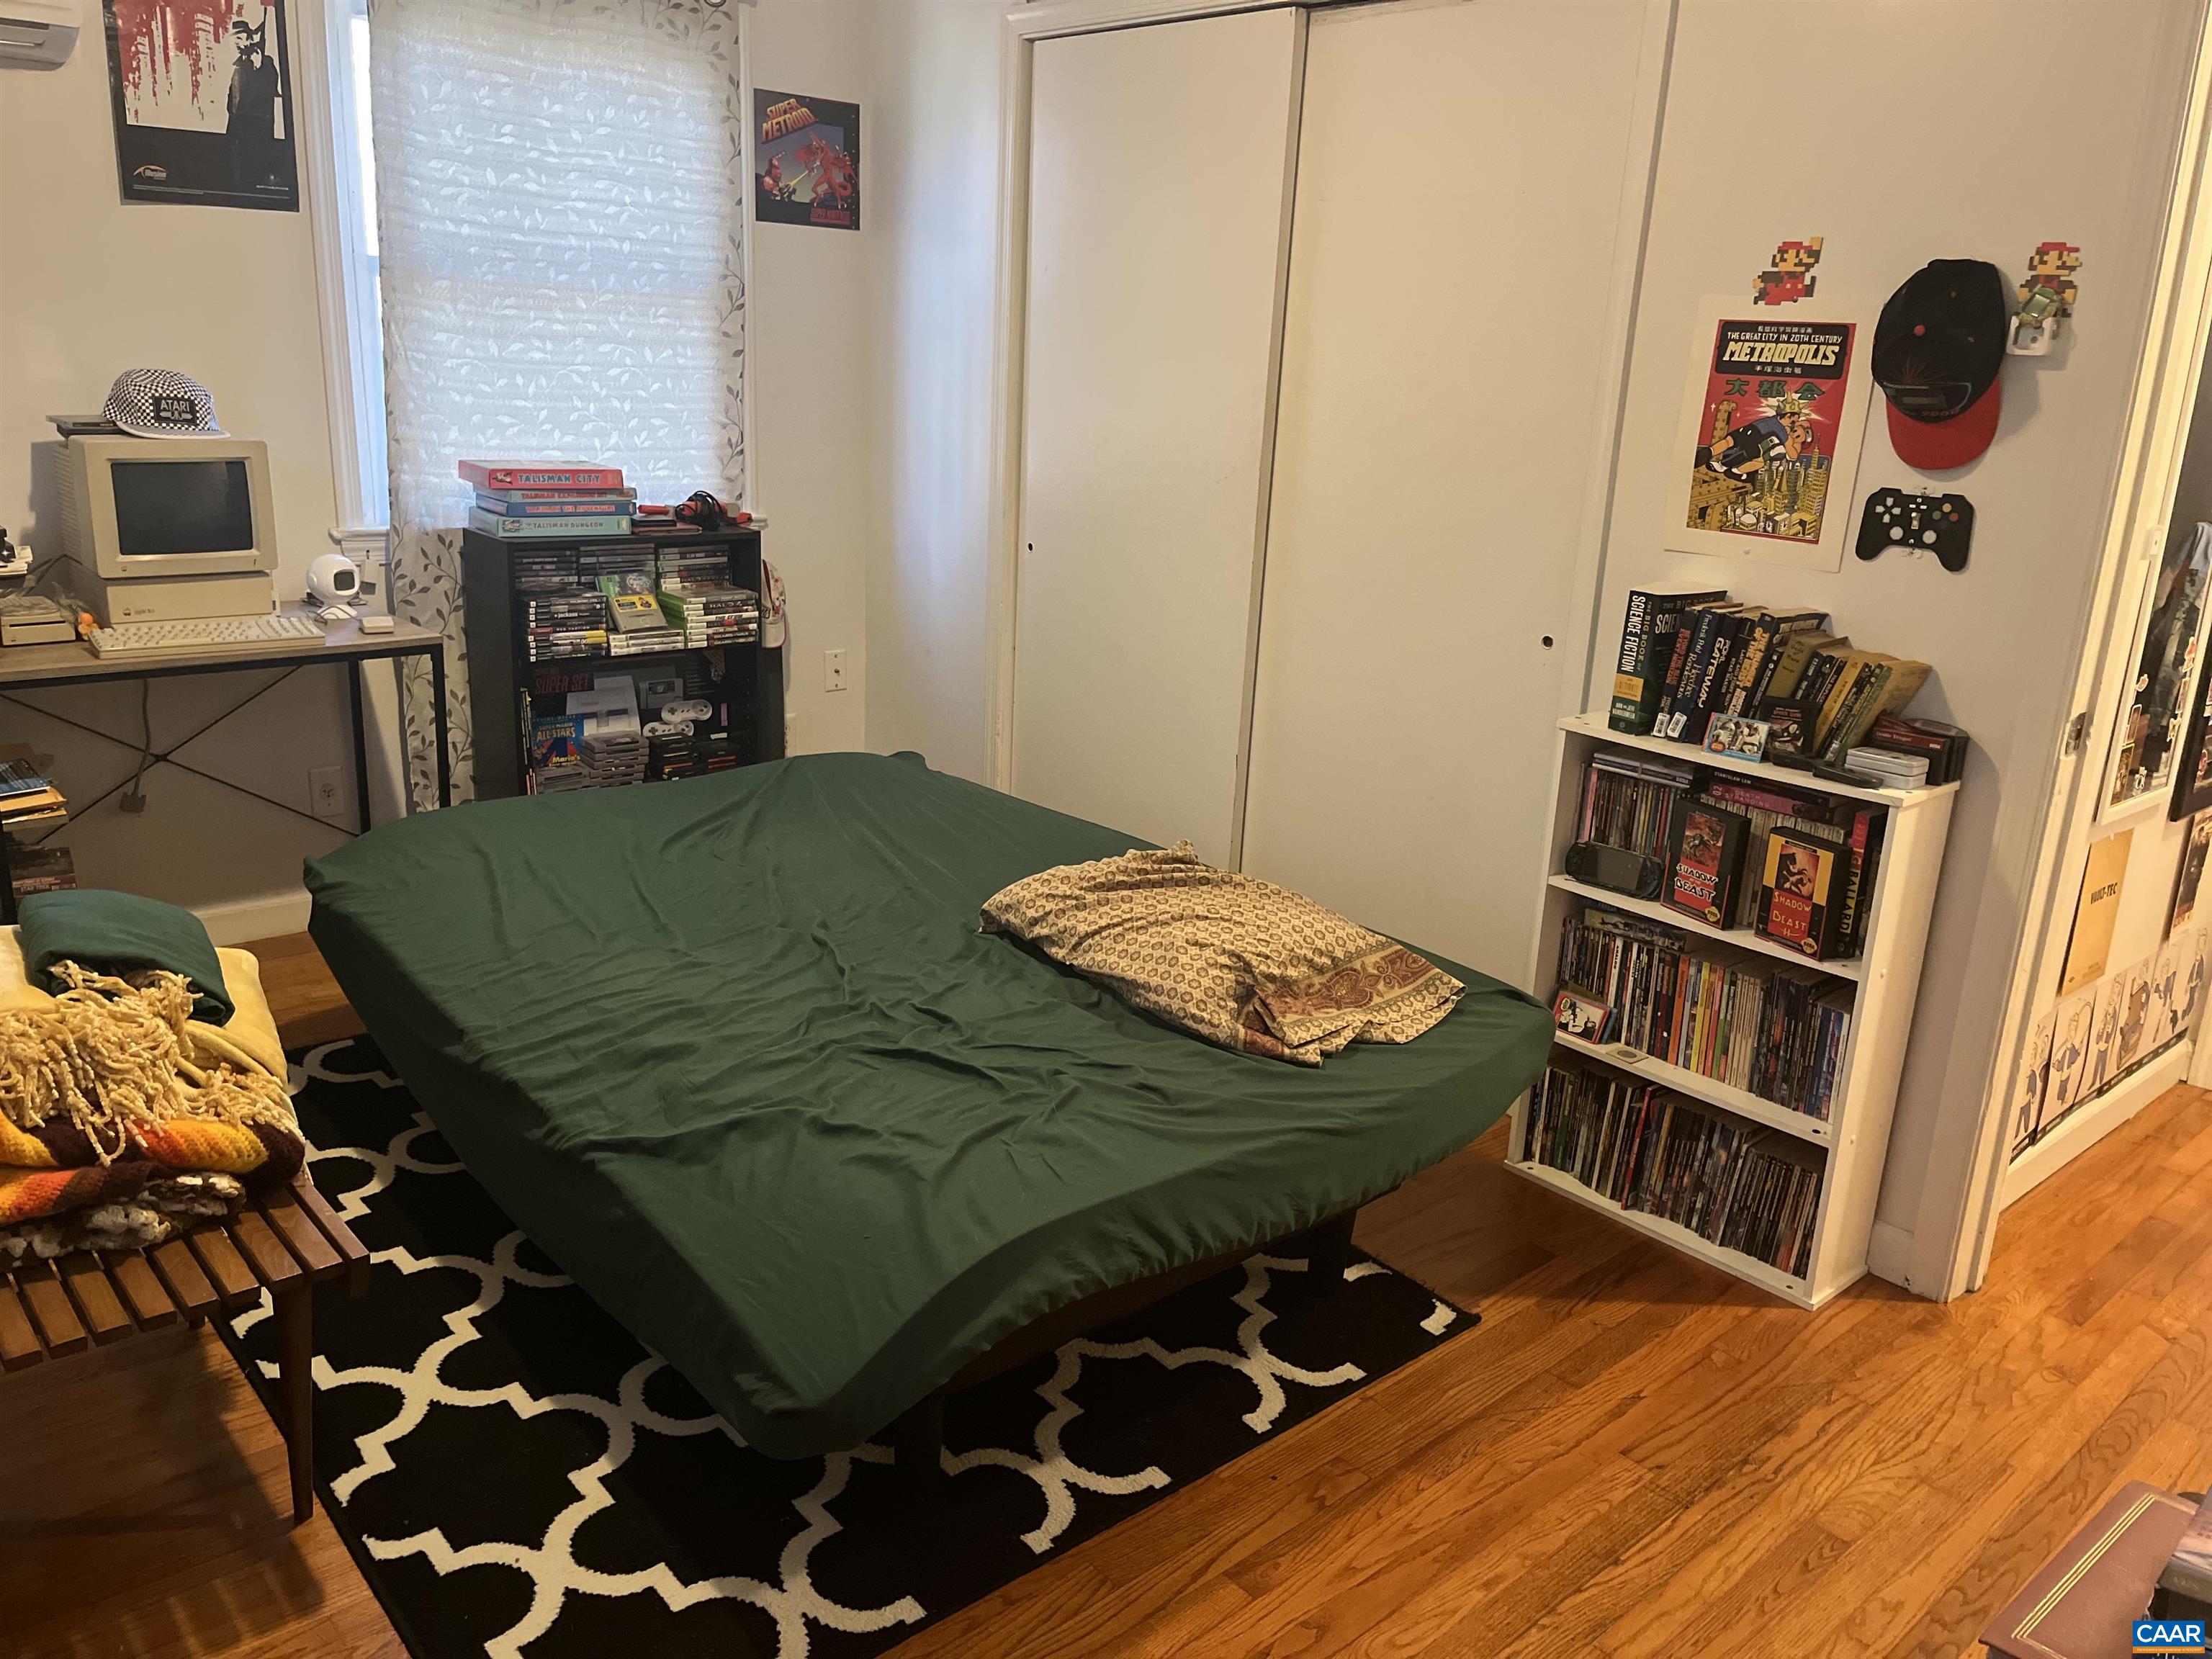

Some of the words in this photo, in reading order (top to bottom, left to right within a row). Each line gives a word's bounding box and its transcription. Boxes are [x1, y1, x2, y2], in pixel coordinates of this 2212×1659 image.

[766, 98, 803, 119] SUPER
[761, 108, 817, 144] METROID
[1728, 332, 1739, 341] THE
[1741, 332, 1760, 341] GREAT
[1762, 333, 1778, 341] CITY
[1810, 335, 1843, 343] CENTURY
[1722, 341, 1840, 366] METROPOLIS
[1725, 377, 1825, 401] 大都会
[161, 400, 189, 412] ATARI
[518, 474, 571, 484] TALISMAN
[577, 474, 601, 483] CITY
[1627, 595, 1646, 634] SCIENCE
[1676, 600, 1691, 608] BIG
[1642, 616, 1651, 631] BIG
[1753, 627, 1763, 641] OF
[1639, 634, 1648, 662] BOOK
[1679, 629, 1691, 653] BEYOND
[1695, 640, 1705, 654] Pohl
[1718, 639, 1731, 664] POHL
[1746, 642, 1758, 659] THE
[1758, 633, 1771, 652] THE
[1621, 636, 1639, 673] FICTION
[1676, 655, 1684, 667] THE
[1677, 653, 1693, 698] Rendezvous
[1698, 637, 1725, 709] GATEWAY
[1745, 652, 1763, 687] NUMBER
[536, 676, 568, 694] SUPER
[572, 674, 588, 691] SET
[1685, 664, 1702, 698] Heechee
[1721, 673, 1730, 693] MAKER
[1714, 771, 1740, 783] STANISLAW
[1725, 793, 1769, 809] STRANDING
[1735, 790, 1761, 799] DEATH
[1676, 863, 1718, 886] SHADOW
[1674, 876, 1716, 902] BEAST
[1840, 869, 1861, 930] BALLARD
[2091, 882, 2118, 905] VAULT-TEC
[1773, 891, 1812, 913] SHADOW
[1772, 910, 1807, 932] BEAST
[1803, 941, 1815, 950] SEGA
